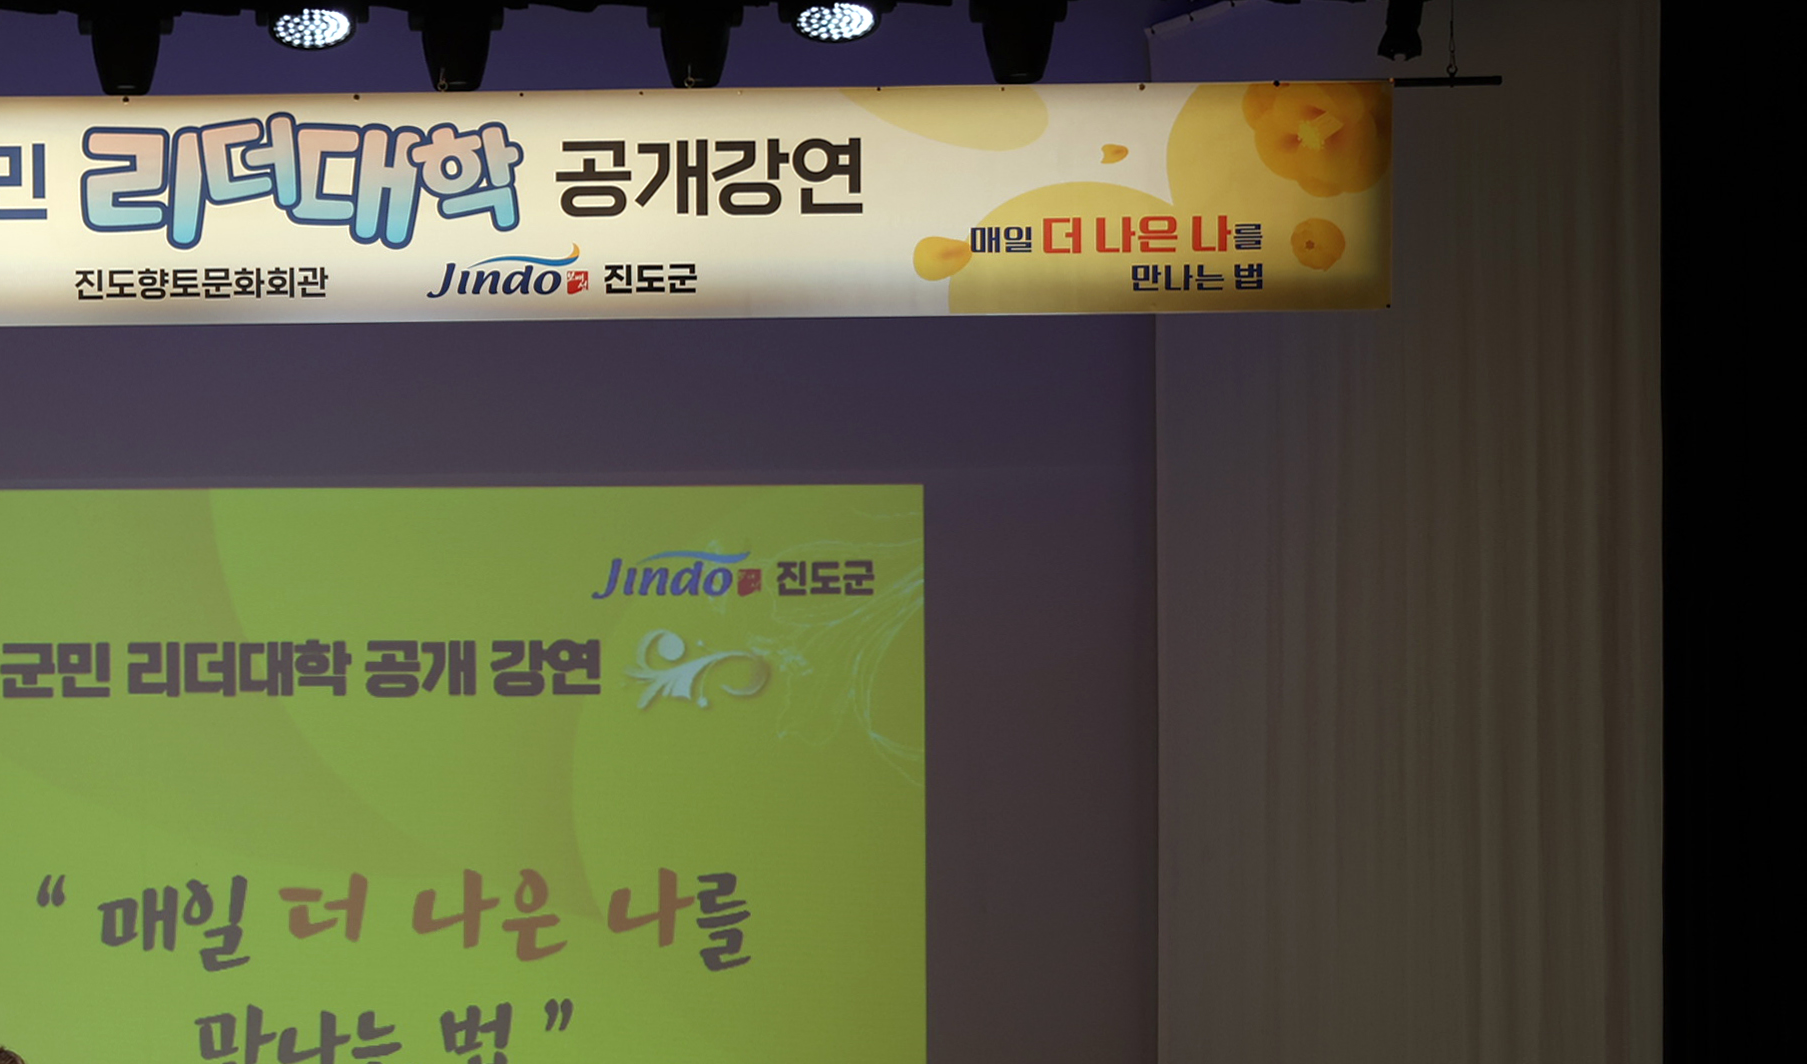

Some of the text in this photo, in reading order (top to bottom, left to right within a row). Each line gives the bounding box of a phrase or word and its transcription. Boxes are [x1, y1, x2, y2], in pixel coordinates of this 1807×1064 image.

[80, 111, 525, 250] 리더대학
[555, 136, 864, 217] 공개강연
[970, 215, 1263, 254] 매일 더 나은 나를
[73, 265, 329, 301] 진도향토문화회관
[426, 262, 562, 298] Jindo
[603, 262, 698, 294] 진도군
[1131, 262, 1264, 292] 만나는 법
[591, 557, 734, 599] Jindo
[776, 559, 875, 597] 진도군
[0, 641, 111, 700] 군민
[126, 639, 352, 698] 리더대학
[365, 639, 477, 698] 공개
[490, 638, 603, 697] 강연
[278, 871, 369, 943] 더
[411, 867, 568, 962] 나은
[606, 866, 752, 972] 나를
